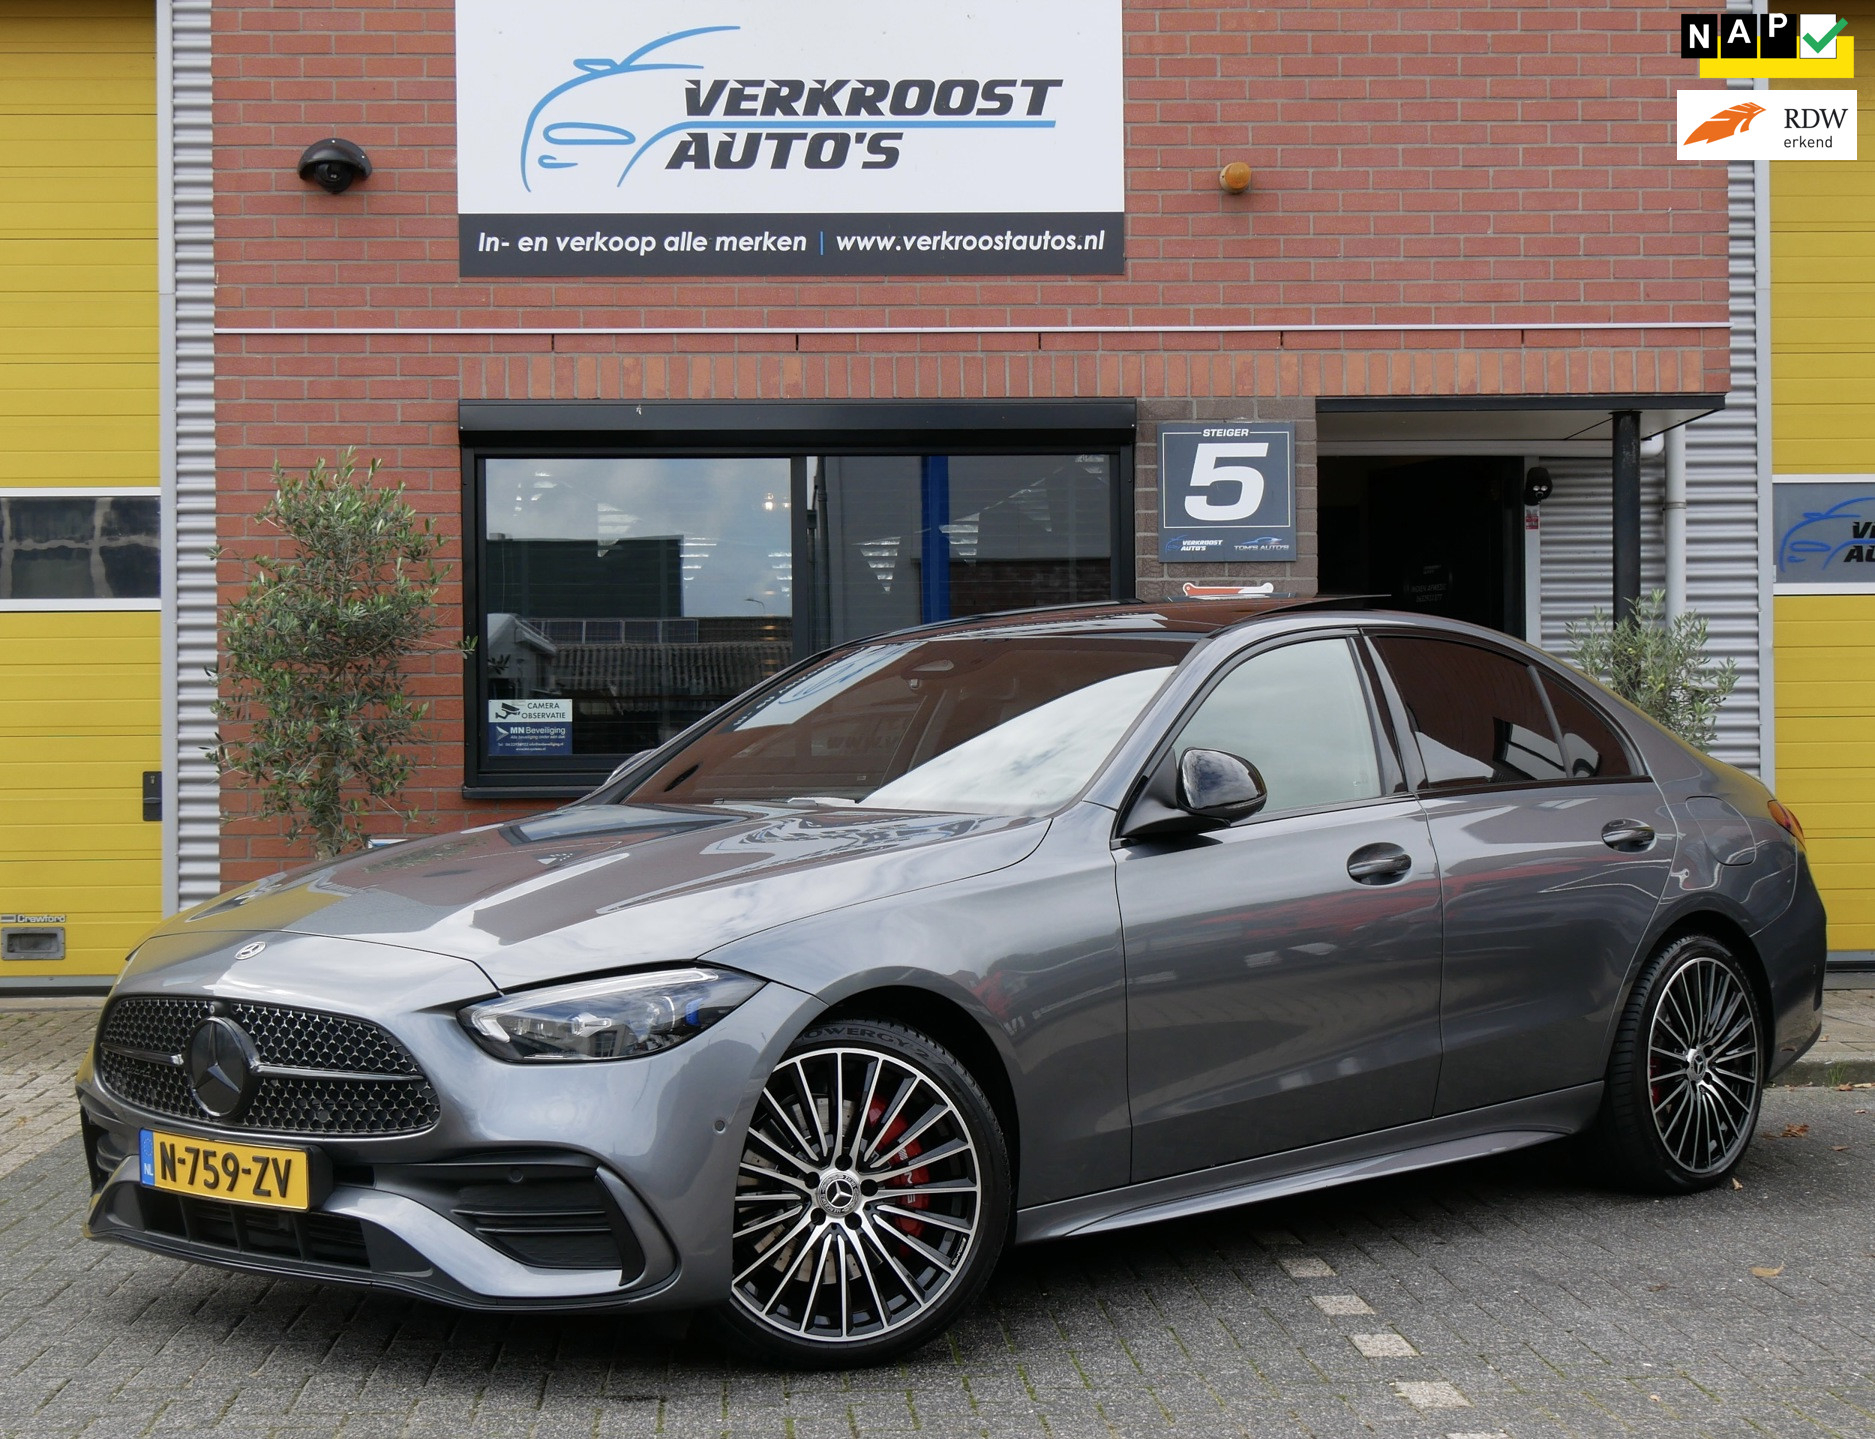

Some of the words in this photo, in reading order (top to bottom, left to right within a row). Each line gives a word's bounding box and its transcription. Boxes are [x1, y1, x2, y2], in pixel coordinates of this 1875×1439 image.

[684, 79, 1063, 117] VERKROOST
[665, 132, 904, 170] AUTO'S
[478, 232, 509, 252] In-
[518, 236, 548, 252] en
[555, 232, 656, 256] verkoop
[664, 231, 707, 252] alle
[714, 231, 807, 252] merken
[836, 230, 1104, 252] www.verkroostautos.nl
[1203, 428, 1249, 437] STEIGER
[1184, 442, 1269, 521] 5
[1852, 521, 1875, 539] V
[525, 726, 566, 735] Beveiliging
[17, 914, 66, 923] Crawford
[143, 1162, 154, 1176] NL
[160, 1141, 292, 1198] N-759-ZV
